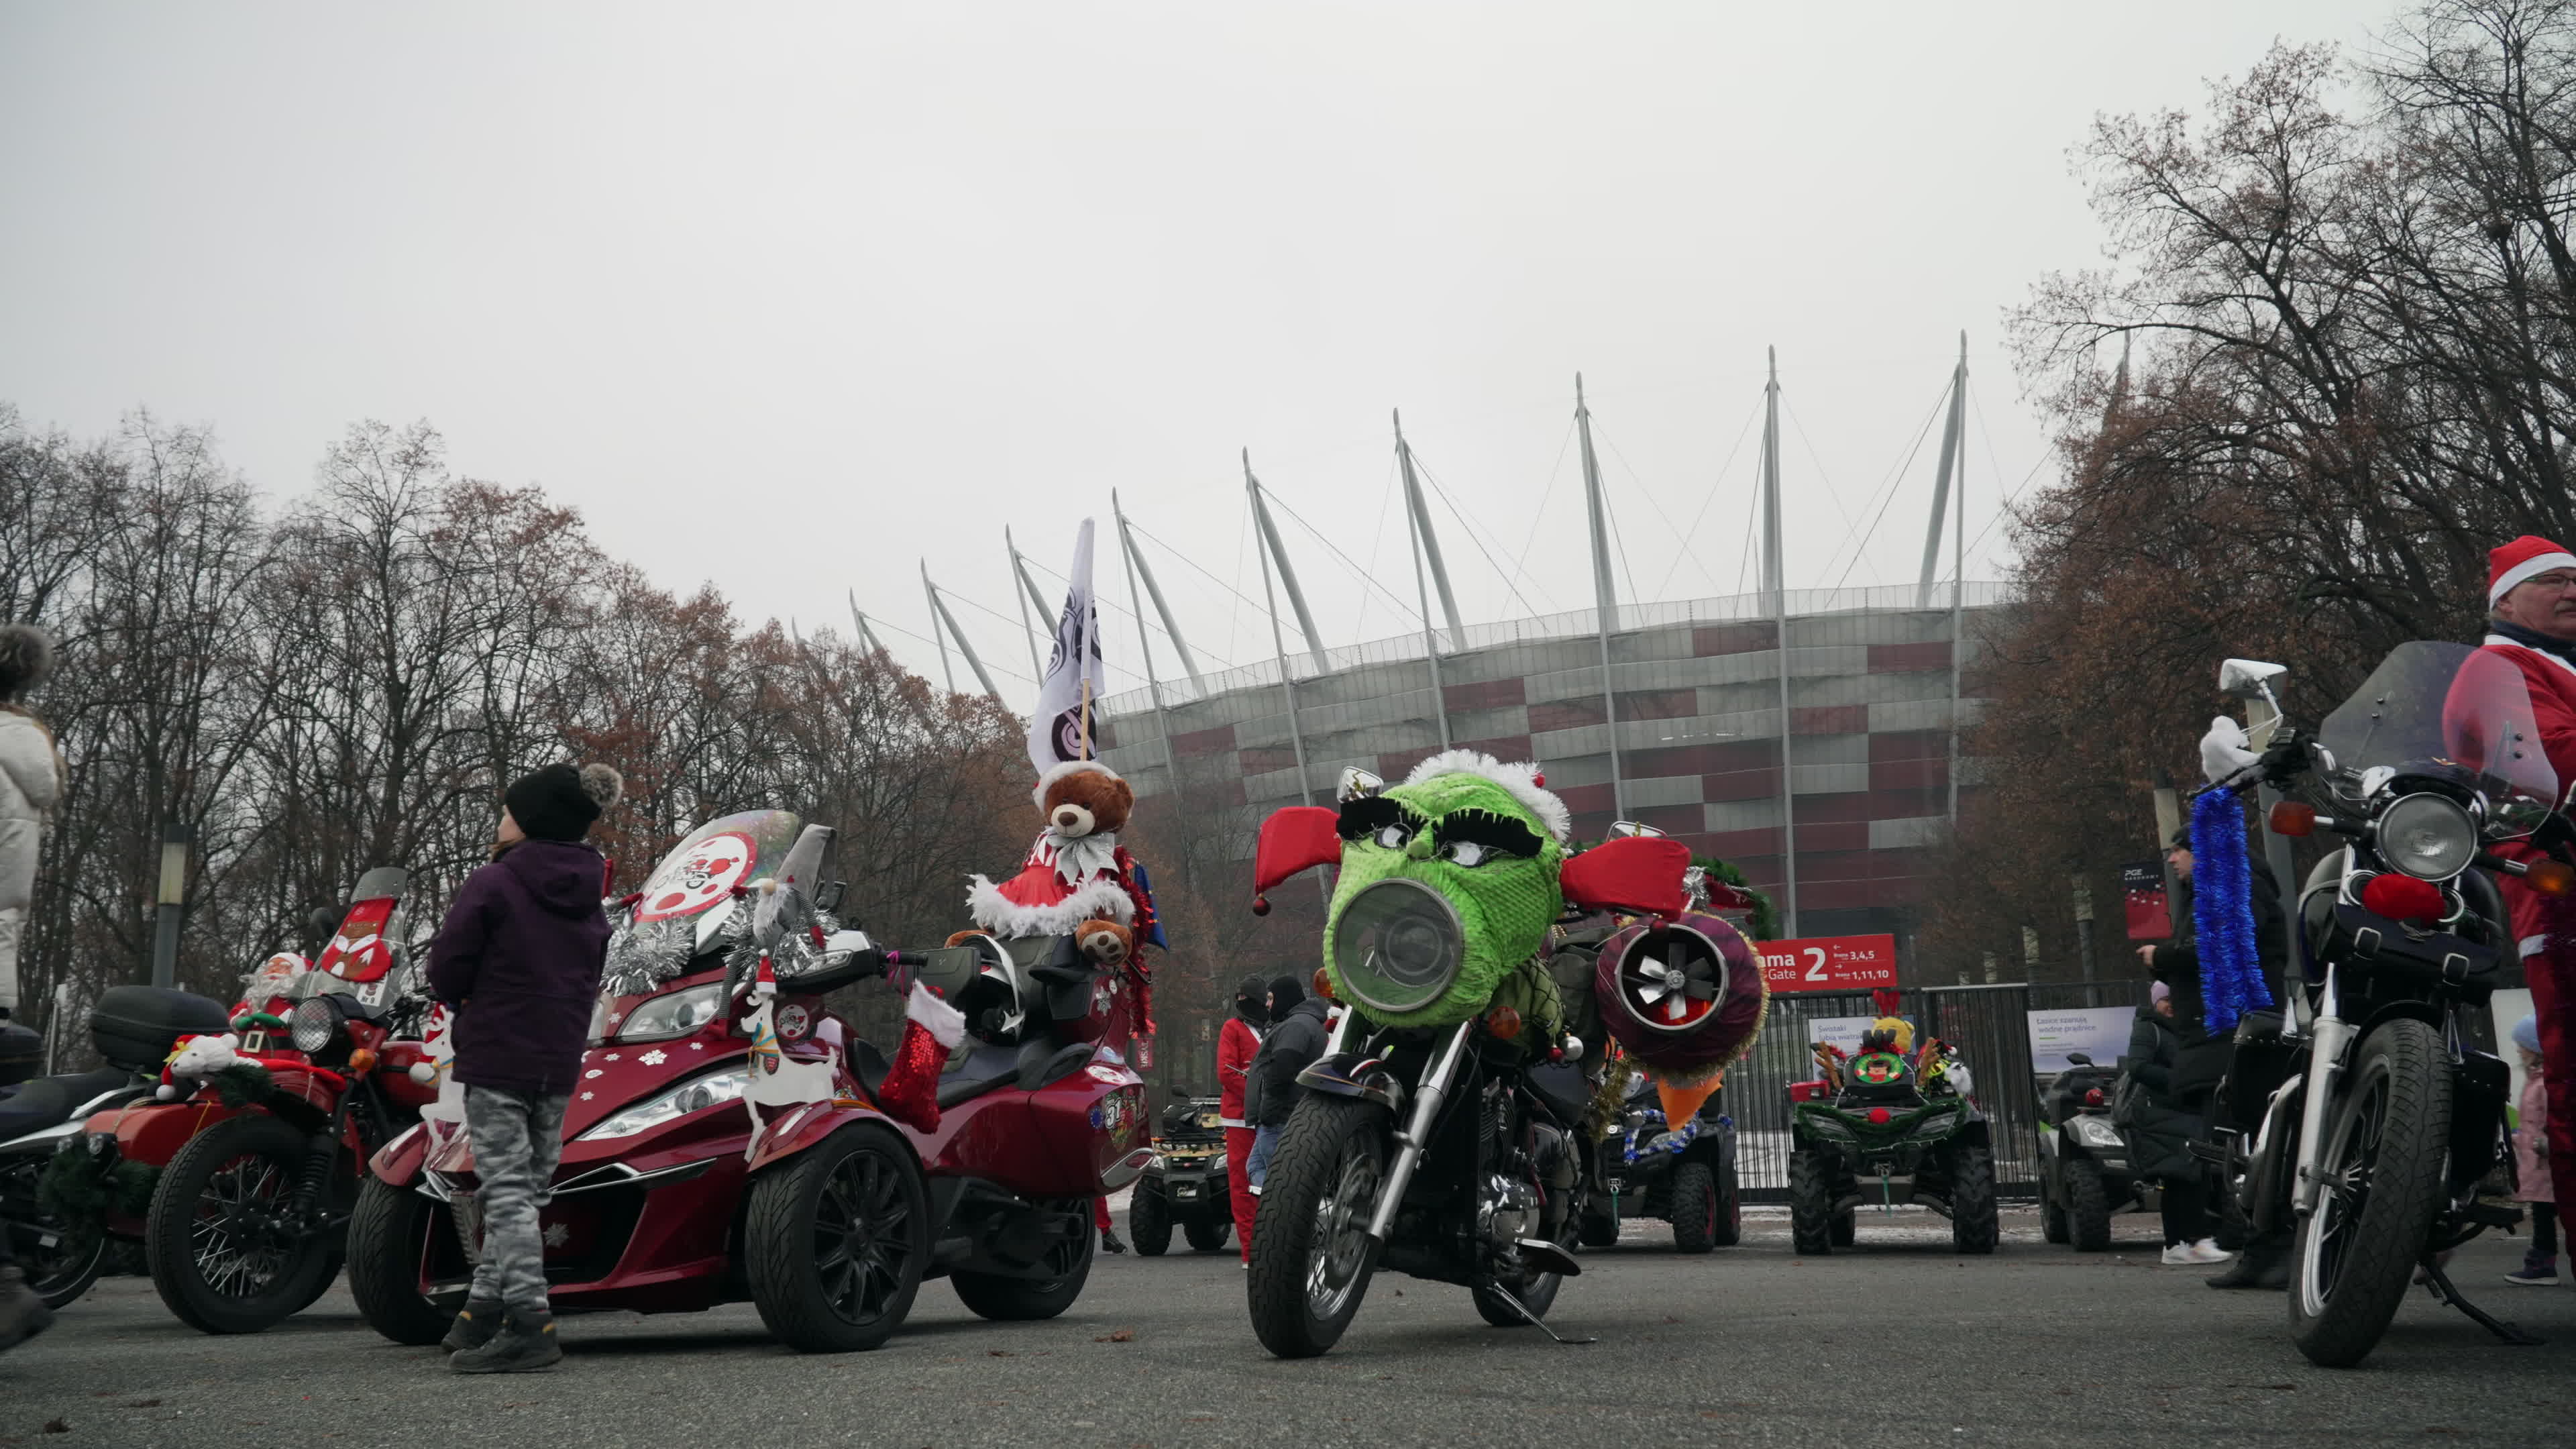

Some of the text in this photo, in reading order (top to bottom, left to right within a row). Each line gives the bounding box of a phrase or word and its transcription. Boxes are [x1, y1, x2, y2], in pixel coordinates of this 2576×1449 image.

[1849, 951, 1875, 961] 3,4,5
[1759, 947, 1829, 981] ama 2
[1768, 969, 1796, 980] Gate
[1852, 969, 1890, 981] 1,11,10
